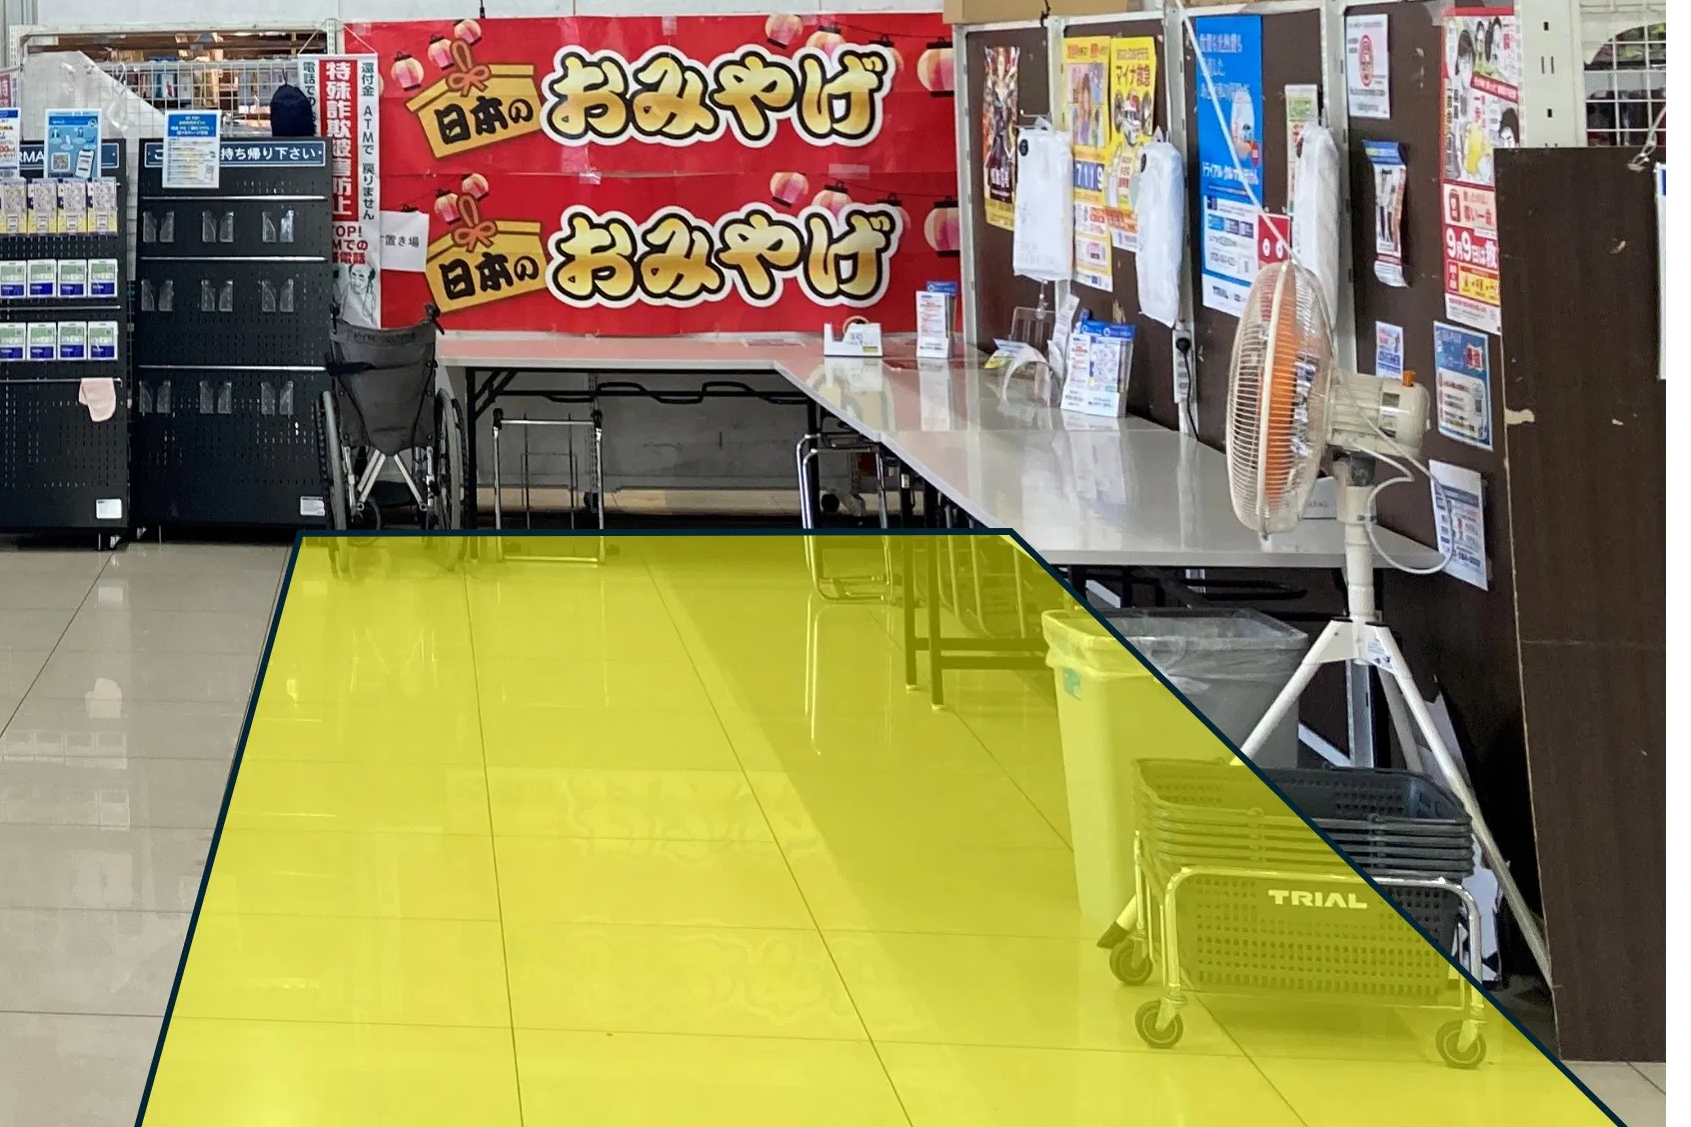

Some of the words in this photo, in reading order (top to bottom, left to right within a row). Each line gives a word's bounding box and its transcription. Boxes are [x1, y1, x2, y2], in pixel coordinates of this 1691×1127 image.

[435, 95, 534, 146] 日本の
[548, 51, 889, 142] おみやげ
[380, 235, 420, 248] 置き場
[552, 210, 896, 302] おみやげ
[439, 249, 540, 301] 日本の
[1267, 889, 1368, 909] TRIAL
